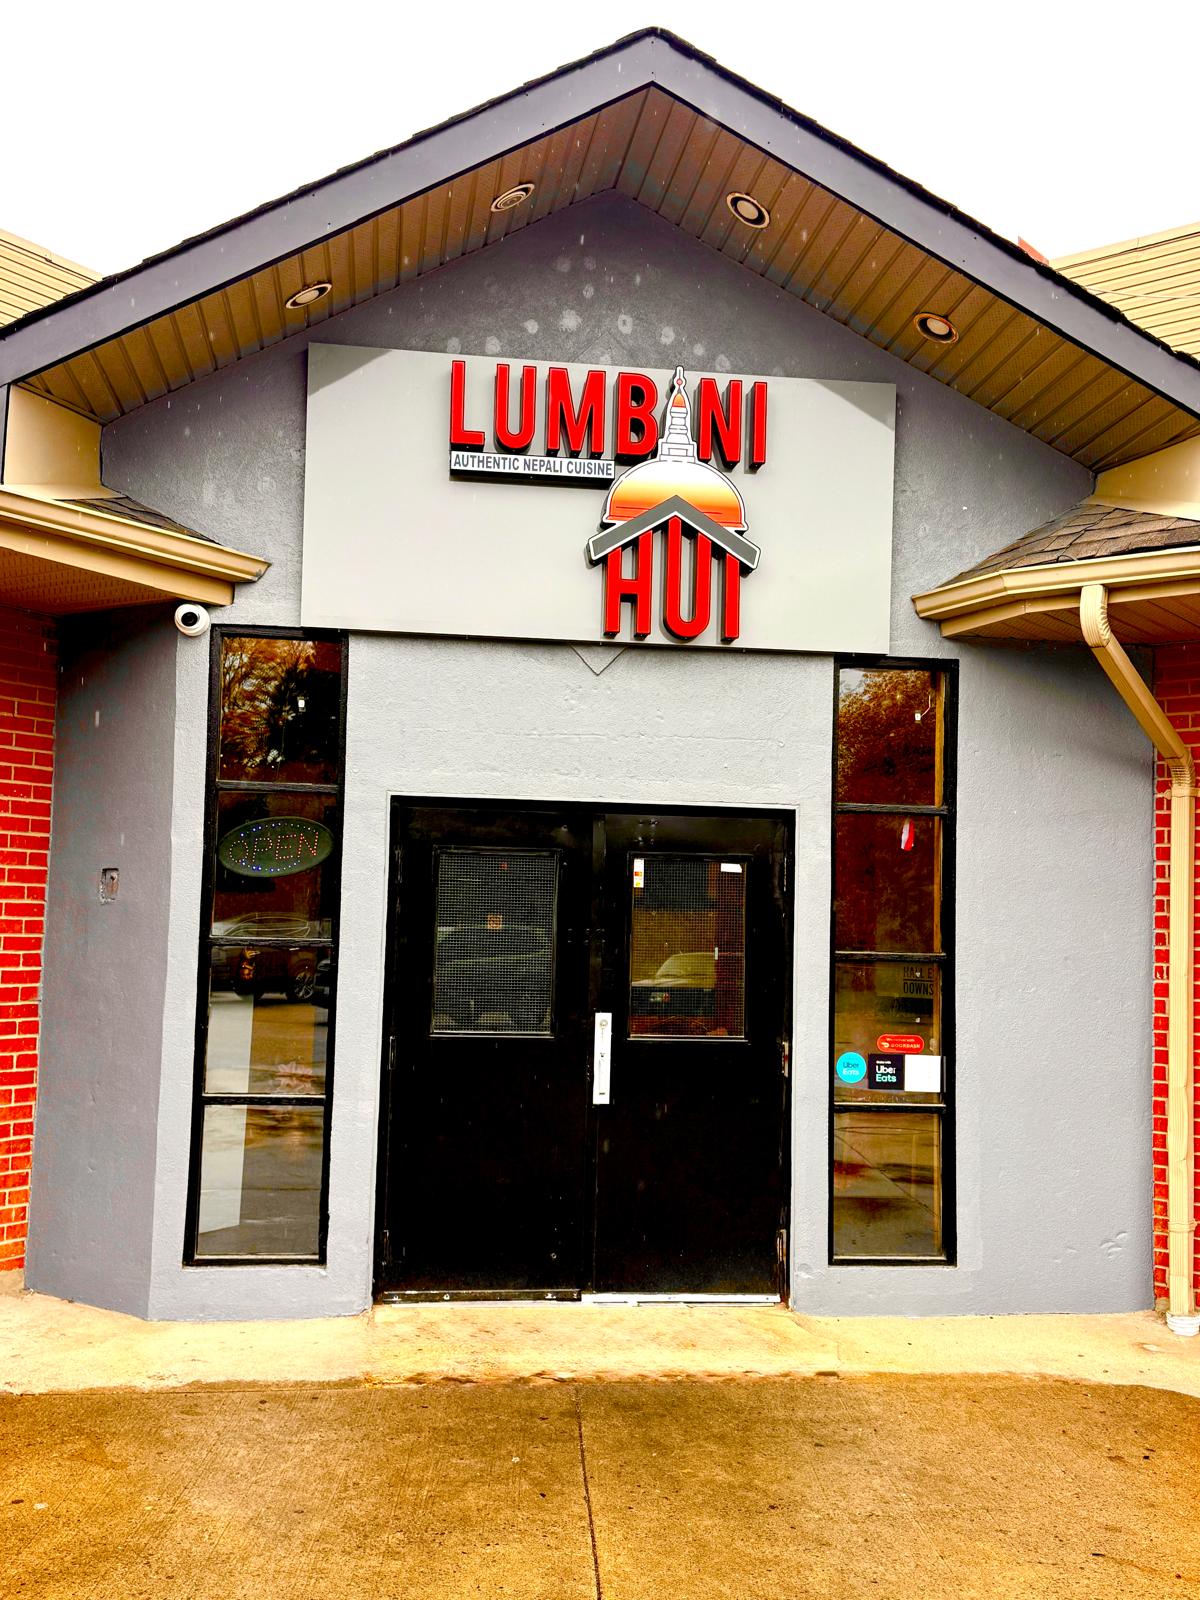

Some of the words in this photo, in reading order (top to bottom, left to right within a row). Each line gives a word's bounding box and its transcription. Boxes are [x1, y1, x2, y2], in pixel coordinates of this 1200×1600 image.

[453, 453, 520, 471] AUTHENTIC
[523, 458, 563, 474] NEPALI
[566, 460, 613, 476] CUISINE
[228, 831, 319, 863] OPEN
[875, 1065, 897, 1074] Uber
[875, 1073, 897, 1083] Eats
